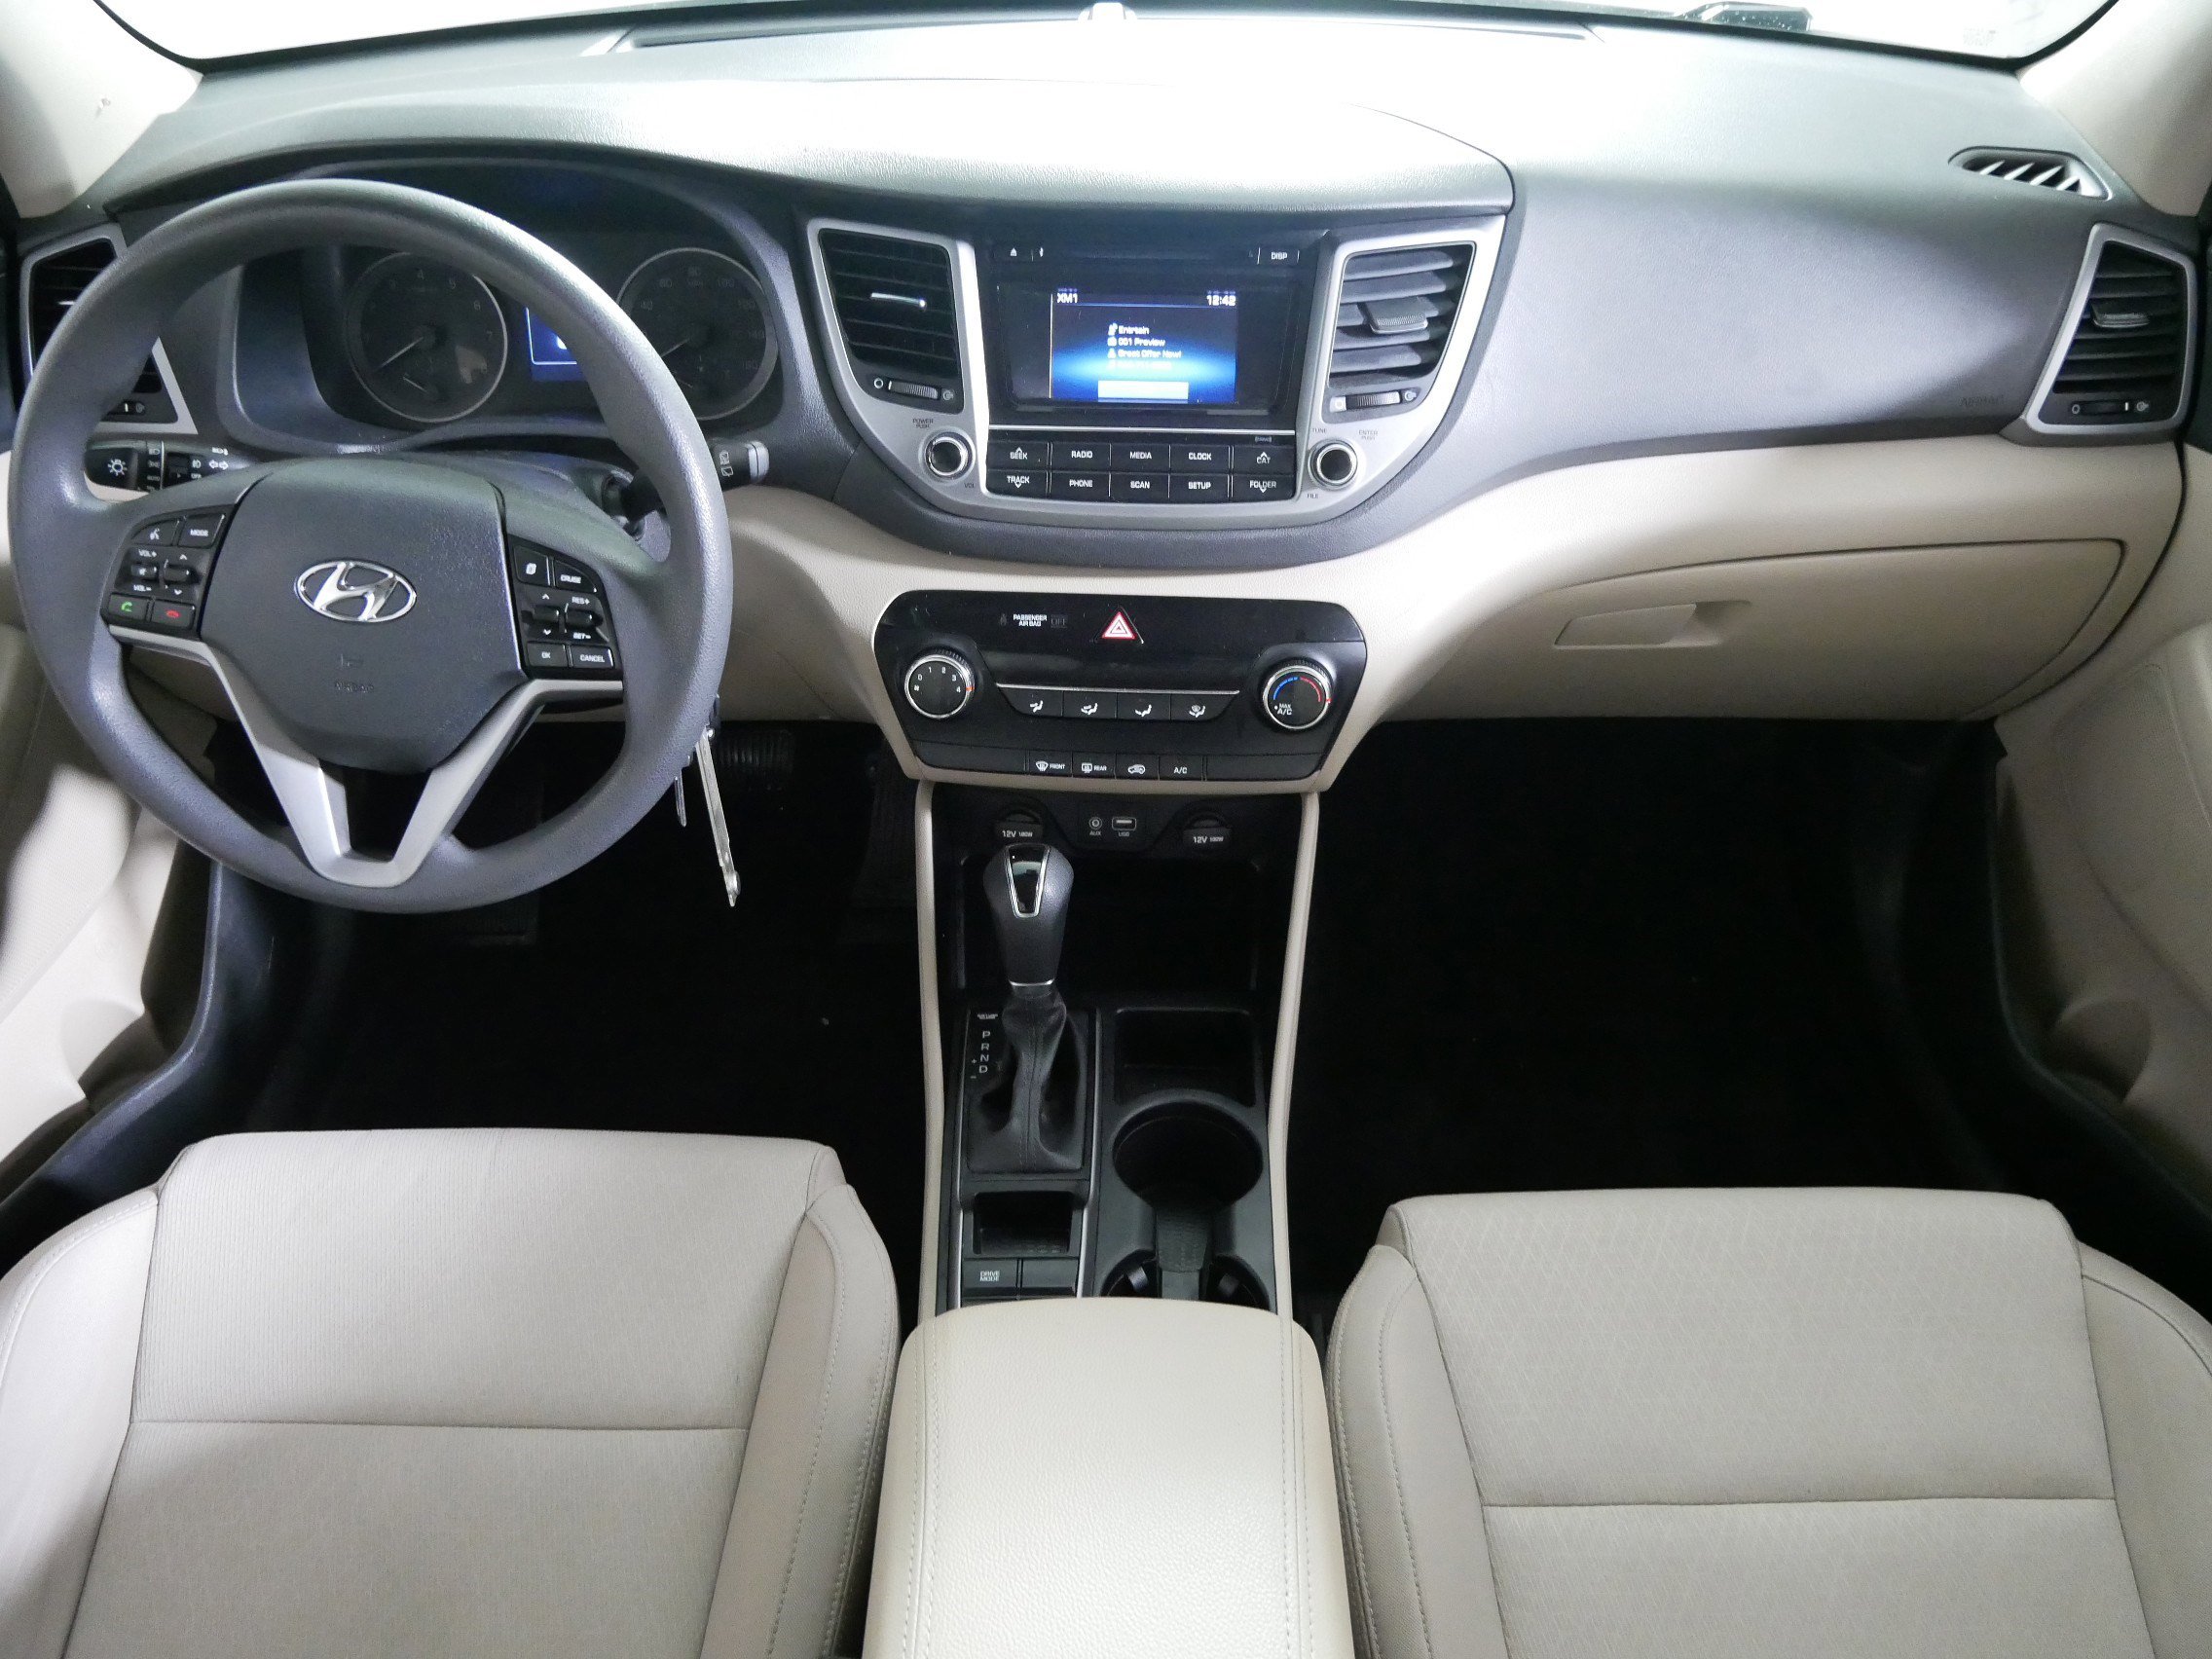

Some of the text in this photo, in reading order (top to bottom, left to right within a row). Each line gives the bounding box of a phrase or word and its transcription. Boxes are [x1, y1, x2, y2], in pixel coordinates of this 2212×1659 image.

[1057, 293, 1079, 304] XM1
[1206, 295, 1236, 307] 12:42
[1134, 338, 1166, 347] Preview
[1188, 481, 1212, 490] SETUP
[561, 574, 581, 584] CRUISE
[1014, 613, 1048, 622] PASSENGER
[580, 654, 606, 663] CANCEL
[981, 1043, 990, 1051] R
[980, 1053, 990, 1062] N
[979, 1065, 988, 1074] D
